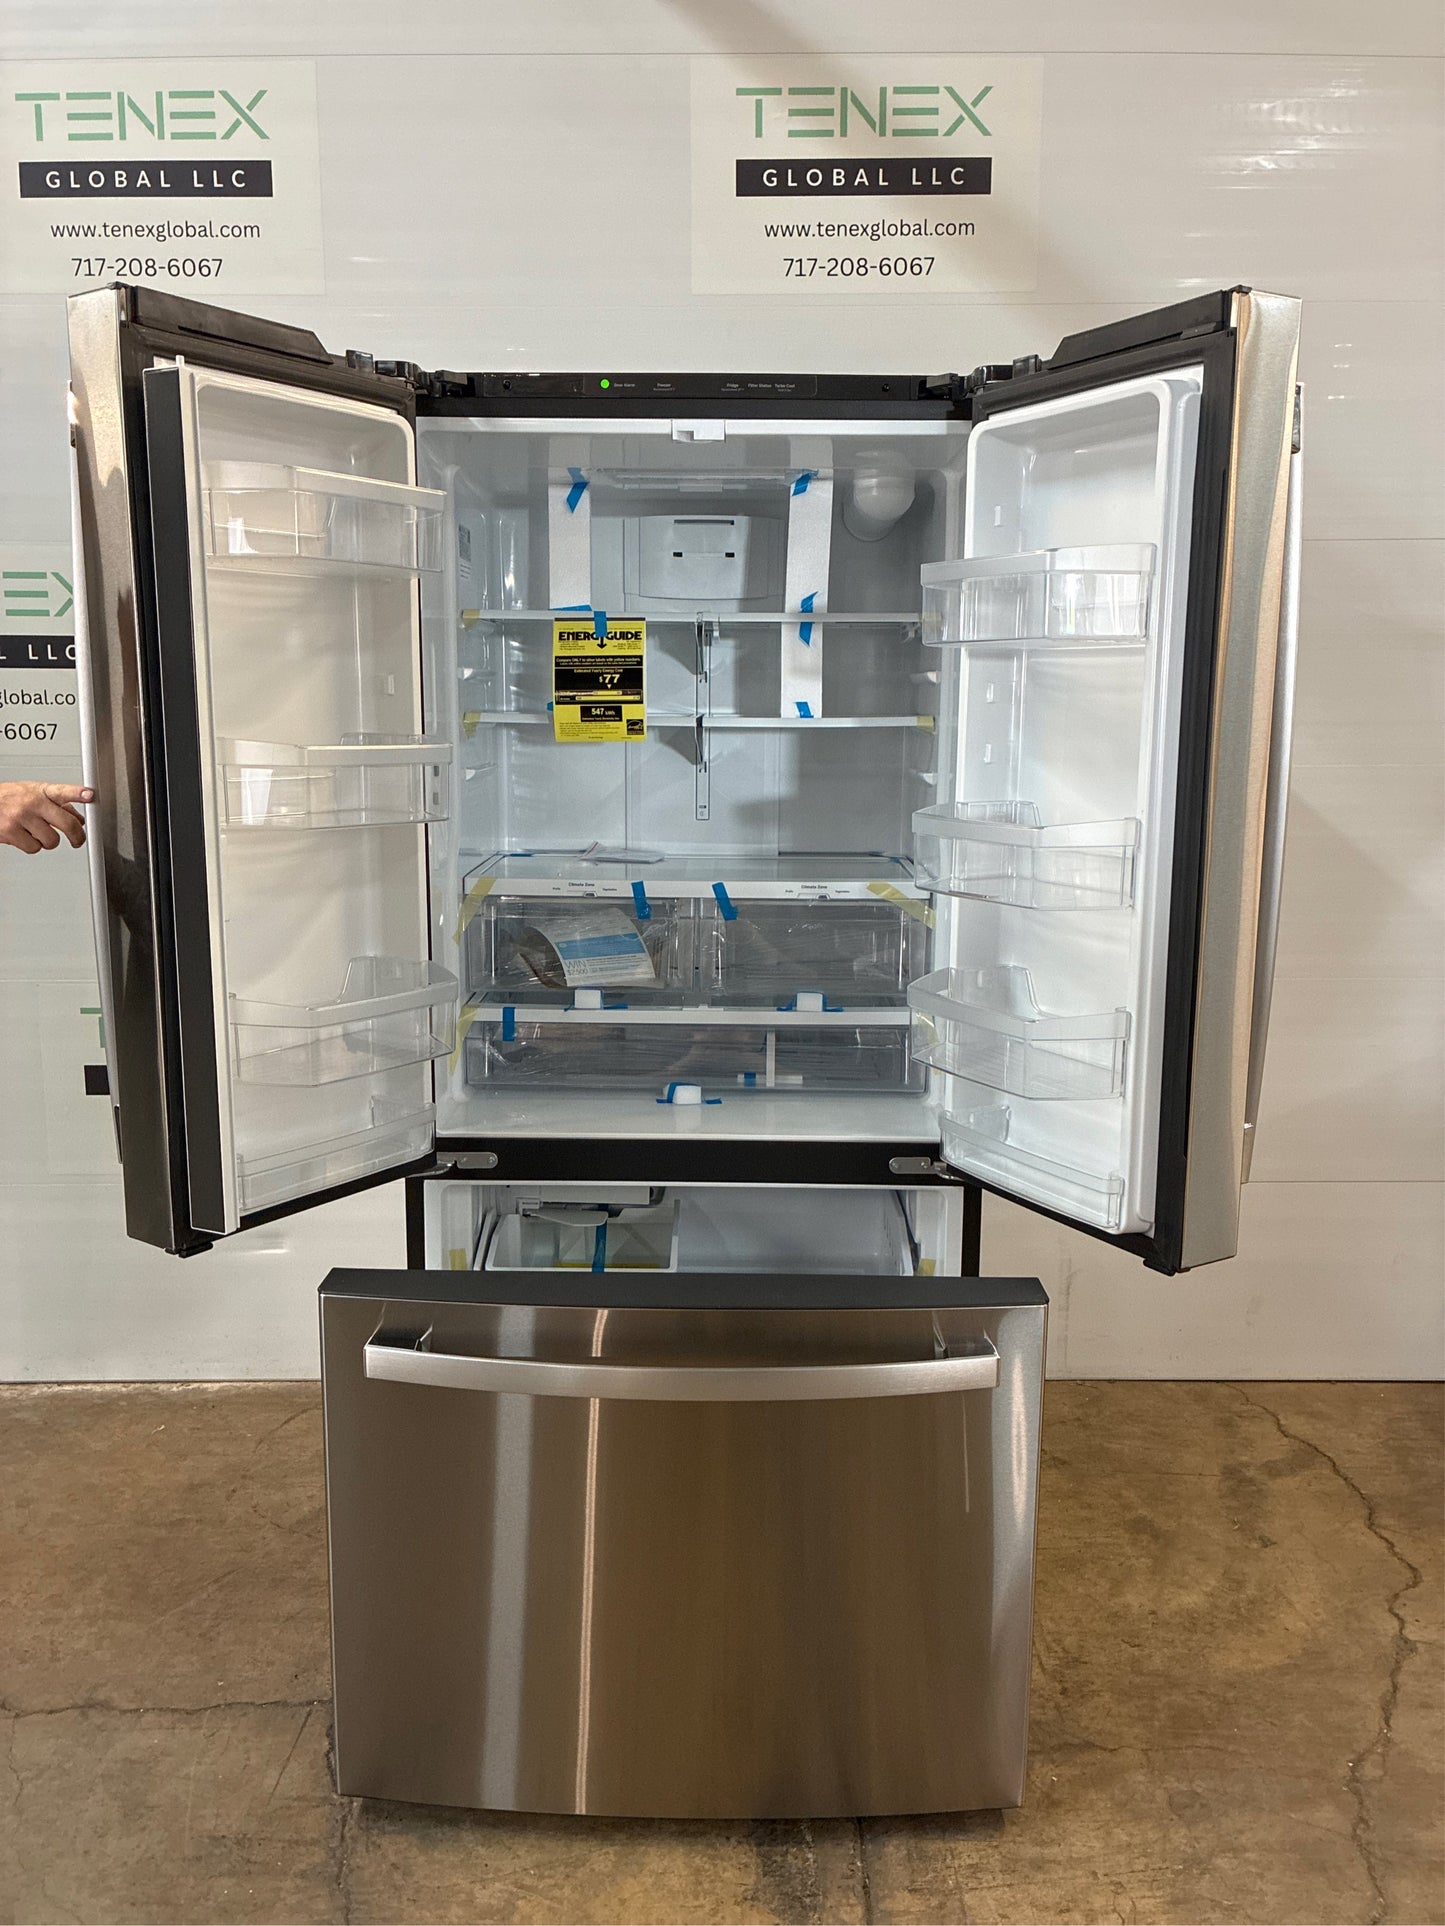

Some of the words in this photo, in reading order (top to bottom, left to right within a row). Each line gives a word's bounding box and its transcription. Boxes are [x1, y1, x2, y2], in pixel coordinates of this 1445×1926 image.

[15, 90, 269, 141] TENEX
[736, 86, 992, 137] TENEX
[45, 170, 171, 189] GLOBAL
[193, 169, 246, 188] LLC
[762, 167, 889, 188] GLOBAL
[912, 167, 966, 186] LLC
[50, 220, 261, 243] www.tenexglobal.com
[764, 218, 976, 242] www.tenexglobal.com
[71, 257, 223, 278] 717-208-6067
[782, 256, 936, 278] 717-208-6067
[558, 630, 642, 641] ENERGGUIDE
[564, 960, 587, 969] WIN
